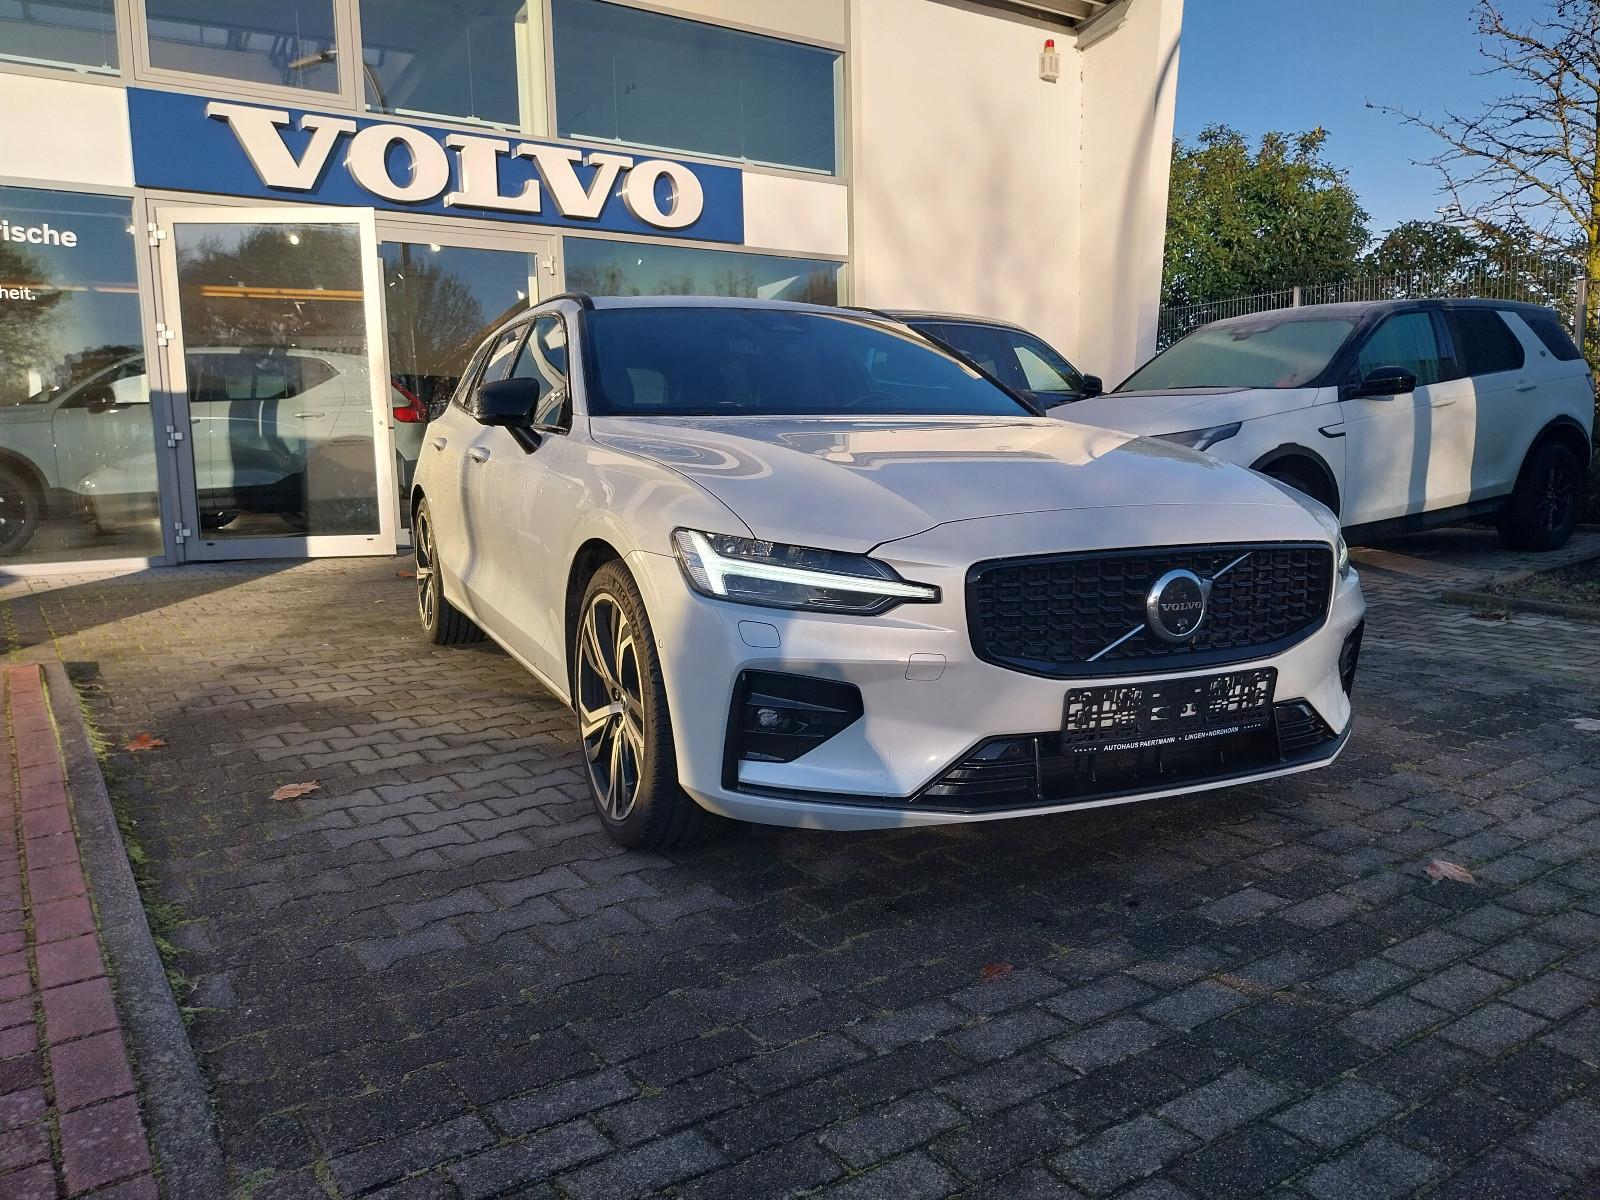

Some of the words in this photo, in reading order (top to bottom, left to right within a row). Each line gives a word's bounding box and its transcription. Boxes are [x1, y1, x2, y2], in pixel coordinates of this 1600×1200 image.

[206, 102, 704, 228] VOLVO
[1161, 601, 1202, 611] VOLVO
[1103, 742, 1139, 751] AUTOHAUS
[1139, 737, 1175, 748] PAERTMANN
